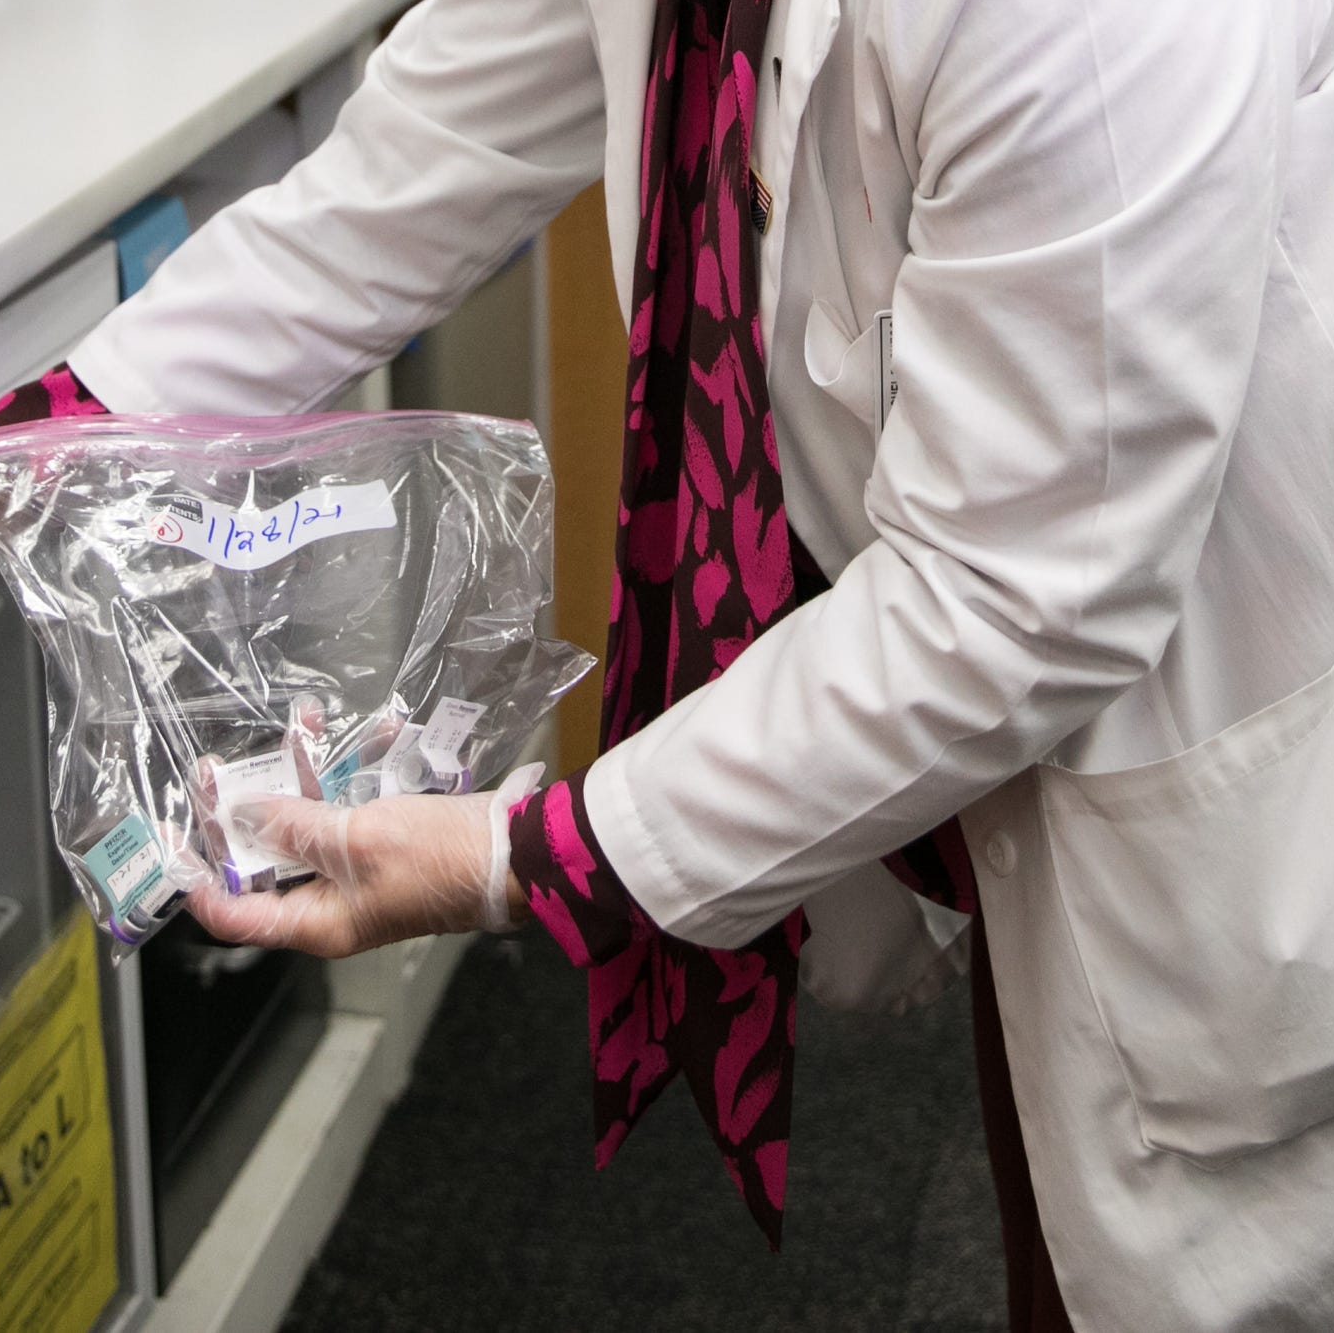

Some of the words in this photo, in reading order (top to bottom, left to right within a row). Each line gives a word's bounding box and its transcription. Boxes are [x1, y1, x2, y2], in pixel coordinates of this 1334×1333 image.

[207, 500, 342, 560] 1/28/21
[104, 827, 128, 850] PFIZER
[21, 1130, 51, 1186] to
[57, 1095, 75, 1138] L
